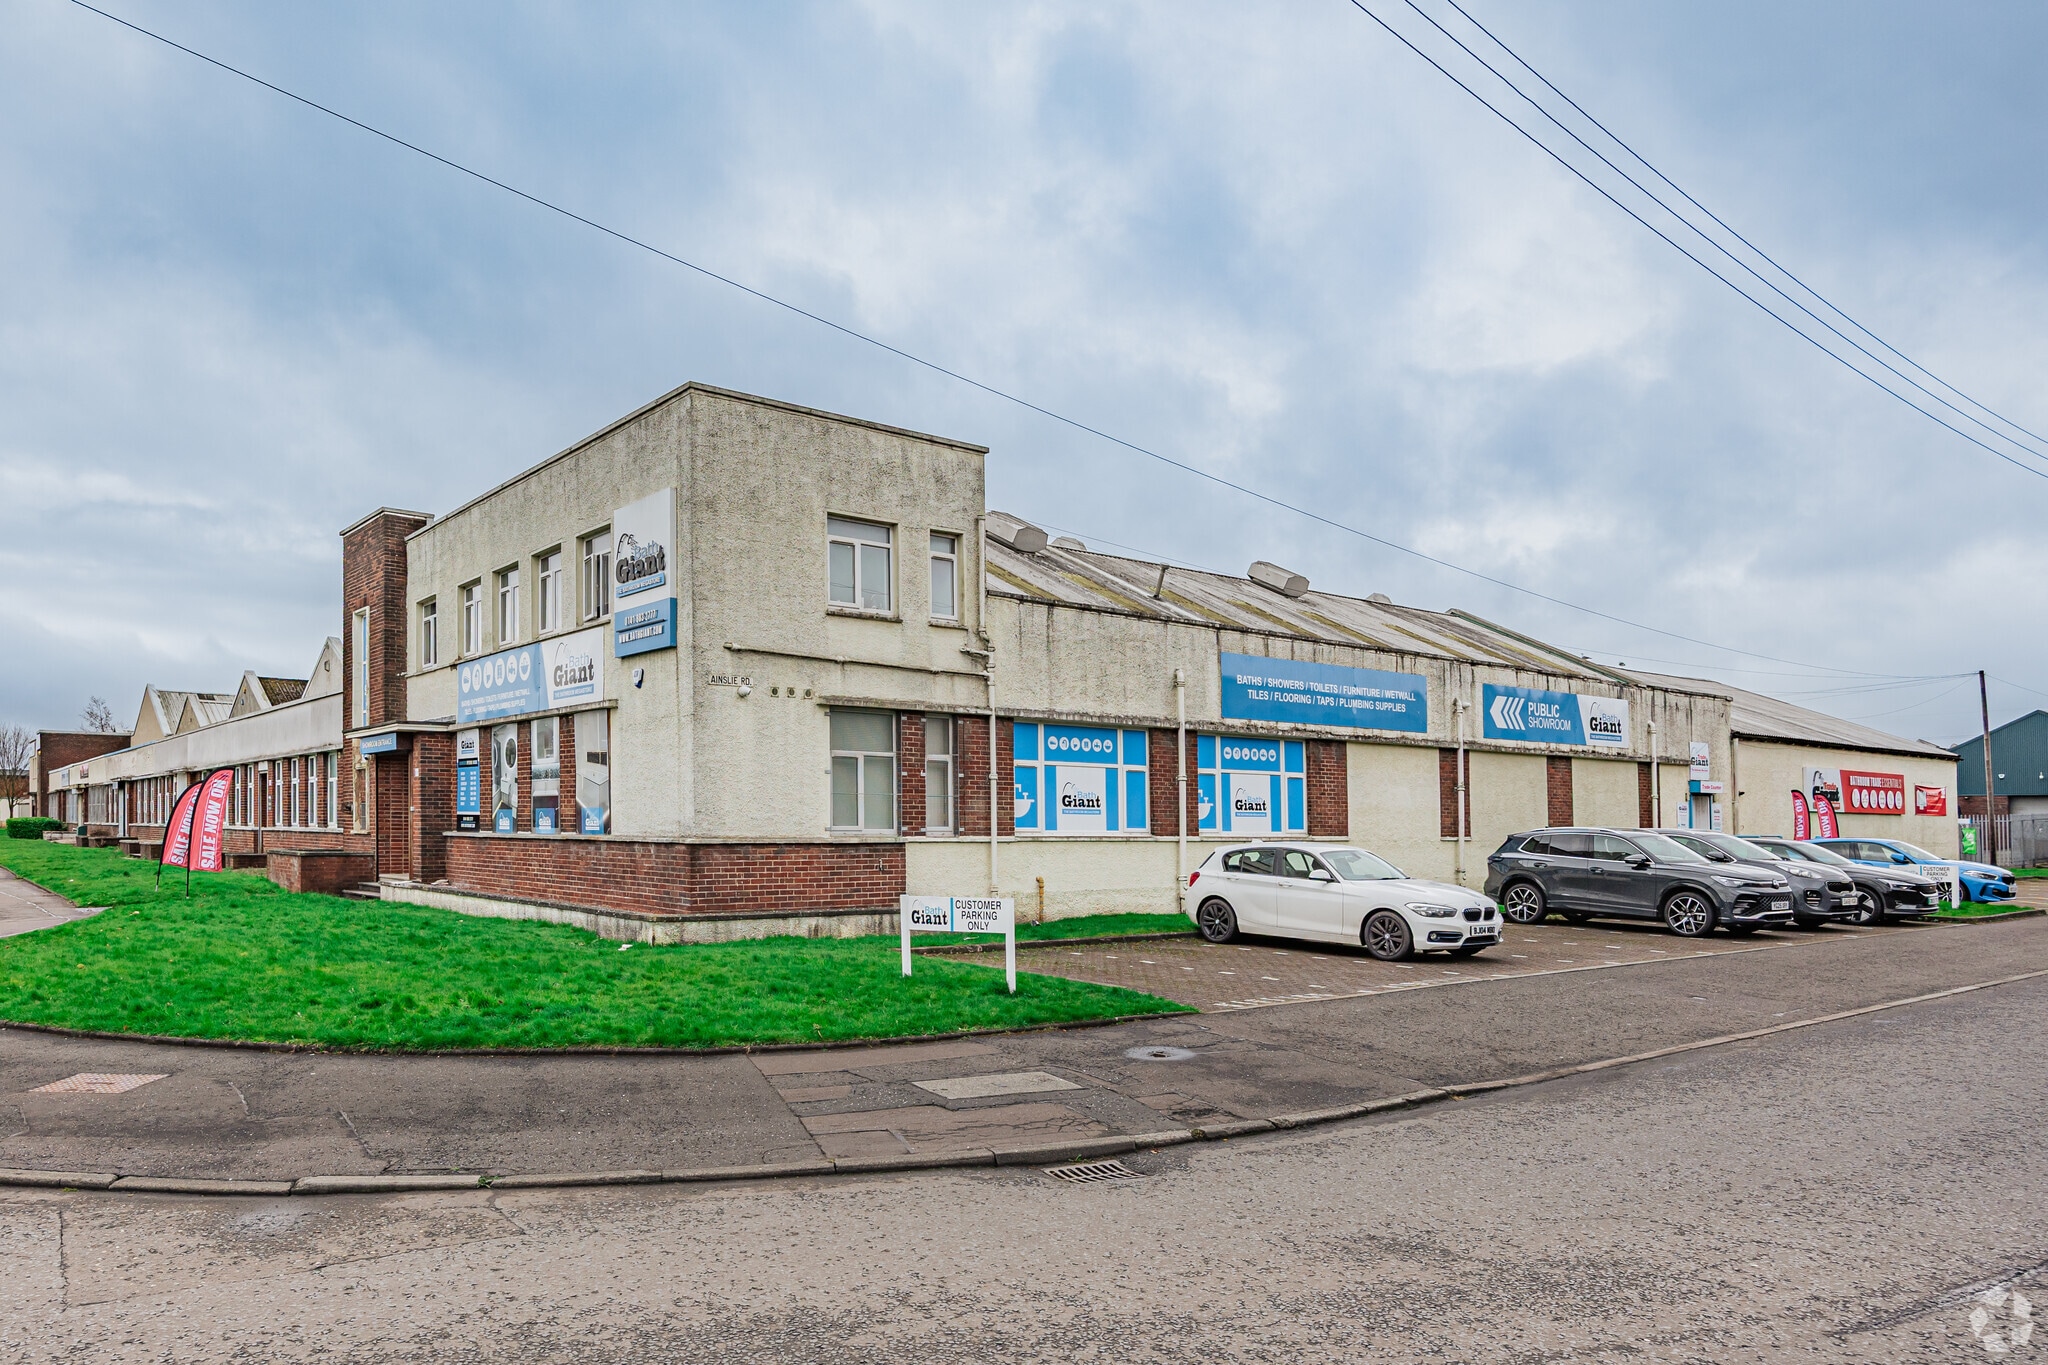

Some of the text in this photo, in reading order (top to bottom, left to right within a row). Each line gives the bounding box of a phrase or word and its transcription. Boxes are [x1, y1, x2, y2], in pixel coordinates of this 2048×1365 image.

[634, 540, 659, 560] Bath
[616, 545, 666, 584] Giant
[569, 652, 590, 668] Bath
[553, 657, 595, 687] Giant
[710, 675, 752, 686] AINSLIE RD.
[1236, 674, 1262, 686] BATHS
[1267, 678, 1304, 691] SHOWERS
[1309, 682, 1338, 694] TOILETS
[1343, 685, 1380, 698] FURNITURE
[1384, 689, 1416, 702] WETWALL
[1247, 689, 1269, 701] TILES
[1274, 692, 1311, 704] FLOORING
[1317, 696, 1334, 707] TAPS
[1339, 698, 1374, 710] PLUMBING
[1375, 701, 1406, 713] SUPPLIES
[1528, 702, 1560, 718] PUBLIC
[1528, 717, 1571, 731] SHOWROOM
[1589, 716, 1622, 734] Giant
[1602, 713, 1618, 723] Bath
[1691, 756, 1709, 766] Giant
[1062, 794, 1101, 808] Giant
[1077, 791, 1097, 799] Bath
[1235, 799, 1267, 811] Giant
[201, 779, 227, 869] SALE NOW ON
[171, 835, 189, 864] SALE
[924, 905, 943, 915] Bath
[955, 899, 1002, 910] CUSTOMER
[911, 909, 948, 926] Giant
[961, 910, 998, 920] PARKING
[967, 921, 990, 931] ONLY
